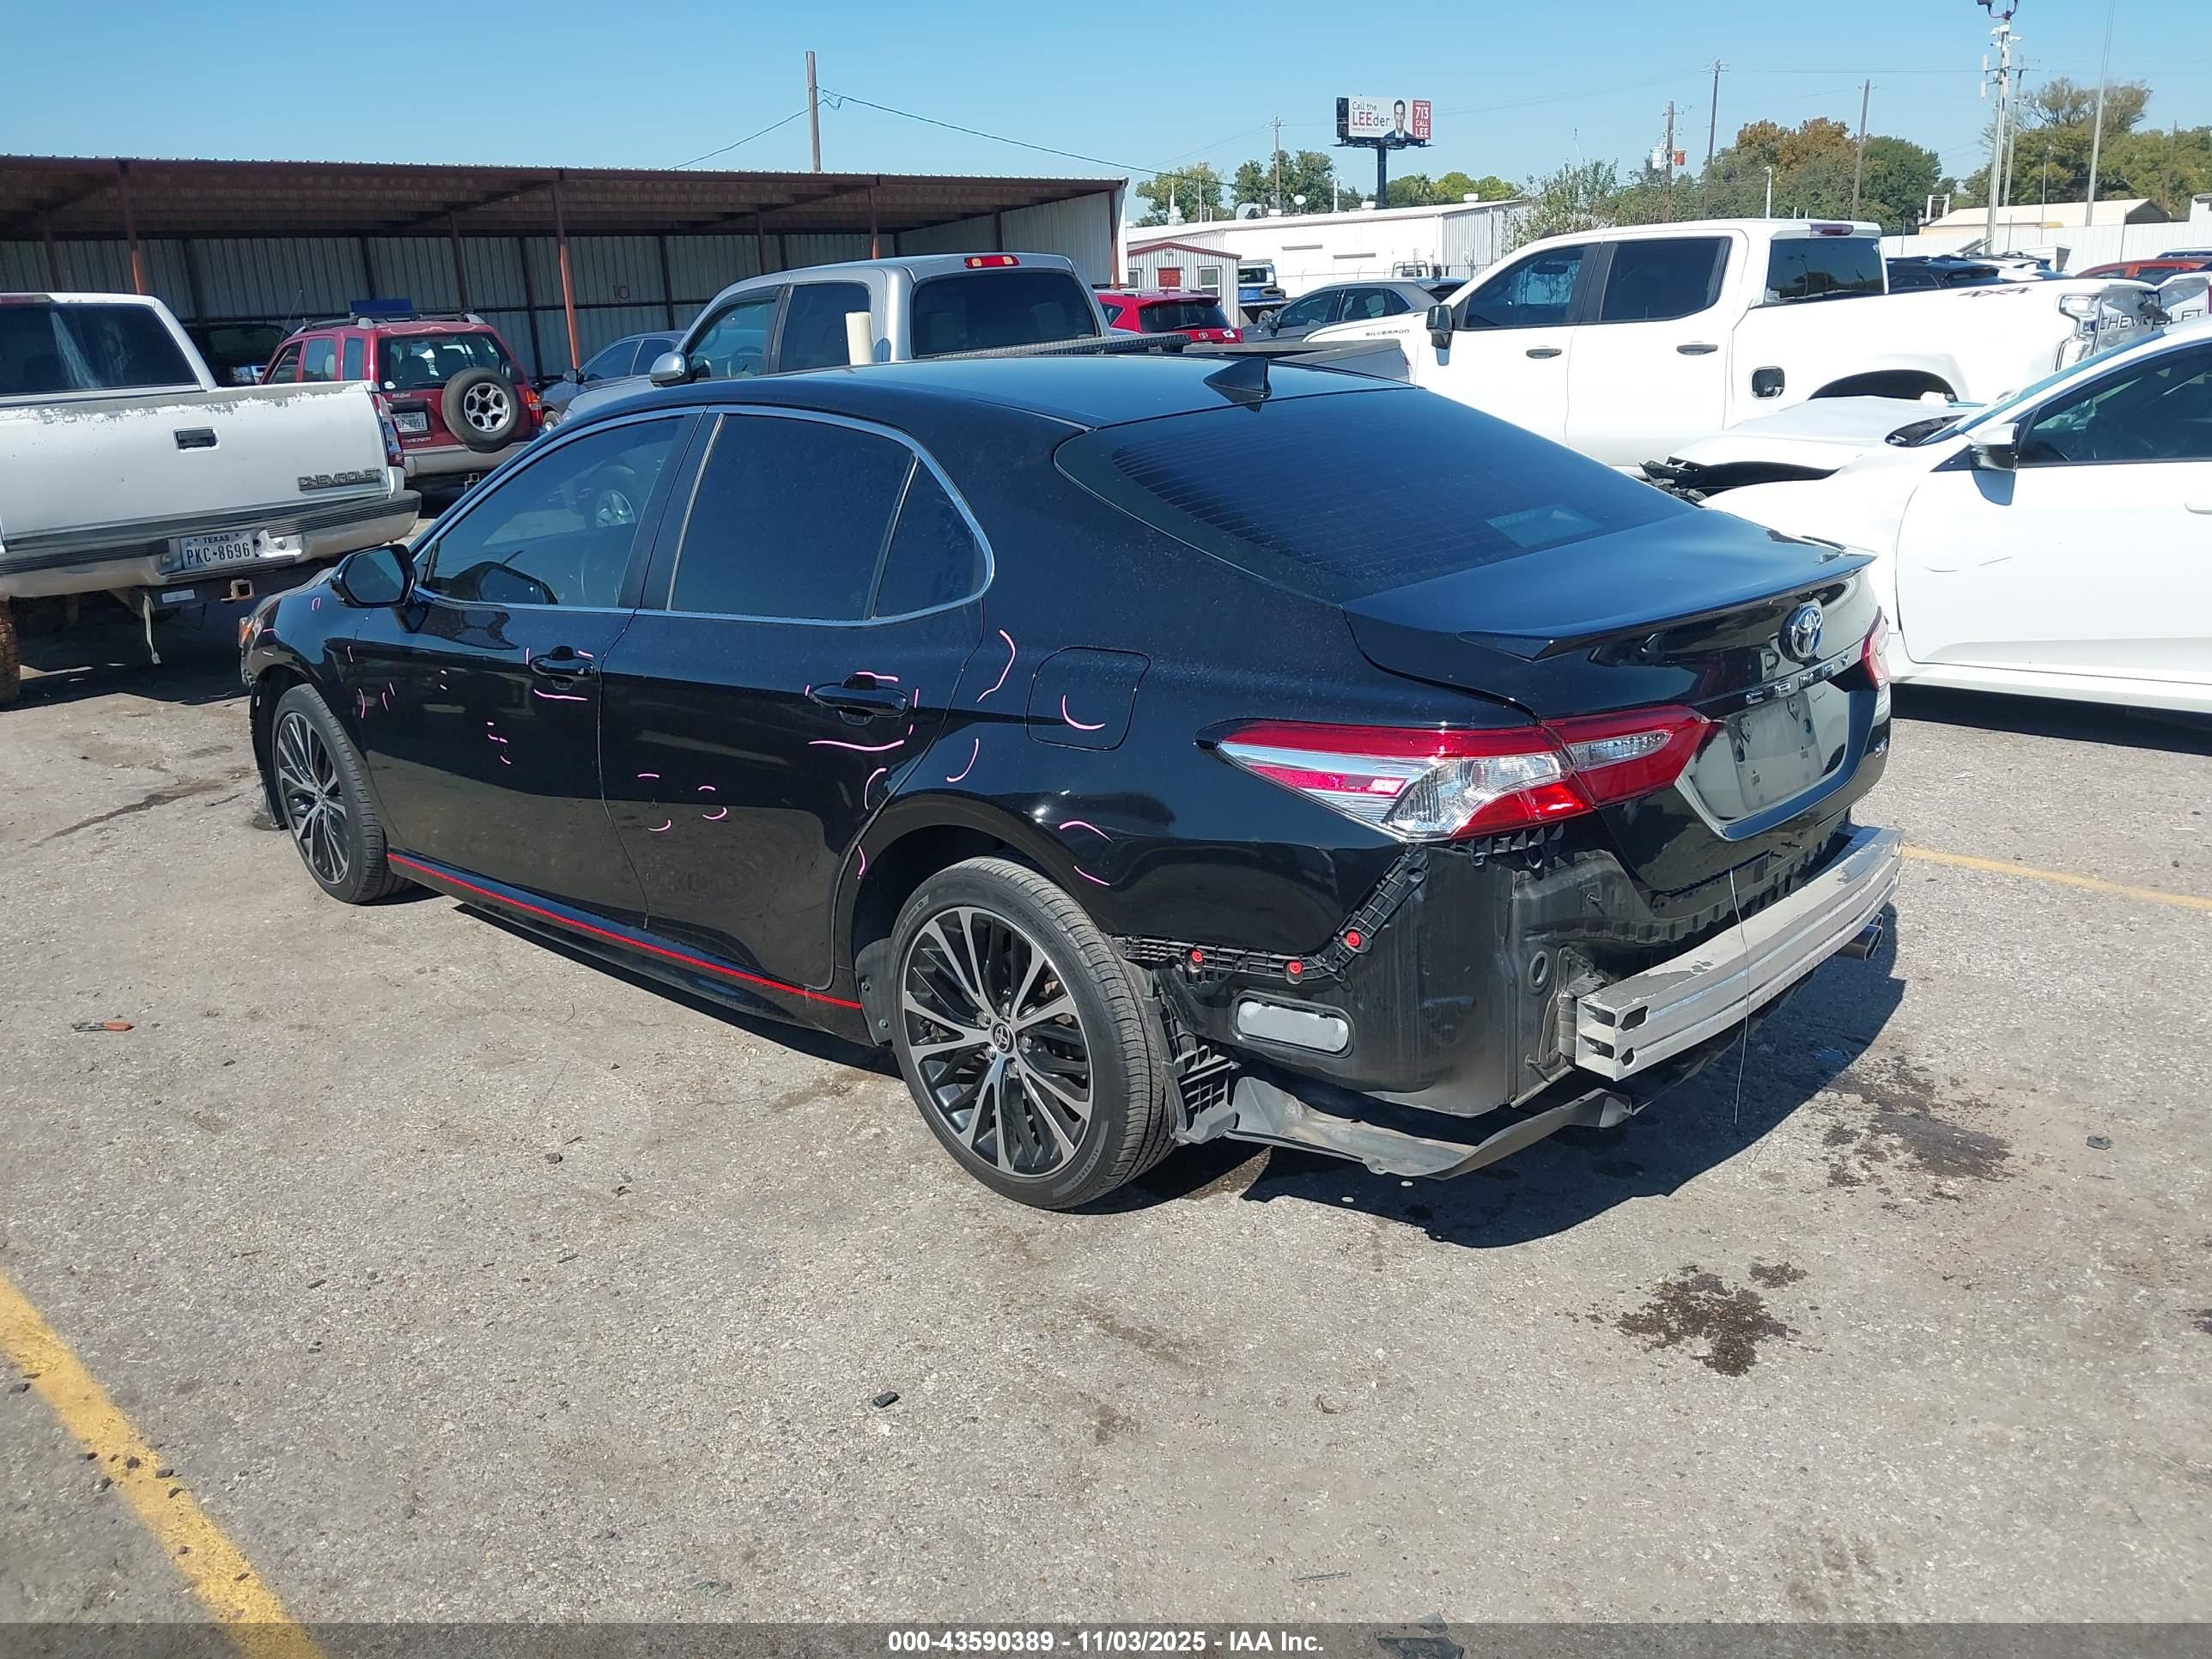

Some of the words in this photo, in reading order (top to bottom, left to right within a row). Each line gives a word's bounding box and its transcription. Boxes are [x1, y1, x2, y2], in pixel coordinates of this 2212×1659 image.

[1352, 101, 1365, 111] Call
[1366, 102, 1377, 111] the
[1415, 106, 1429, 119] 713
[1415, 127, 1429, 137] LEE
[297, 468, 383, 487] CHEVROLET
[203, 534, 230, 544] TEXAS
[1745, 653, 1850, 705] CAMRY
